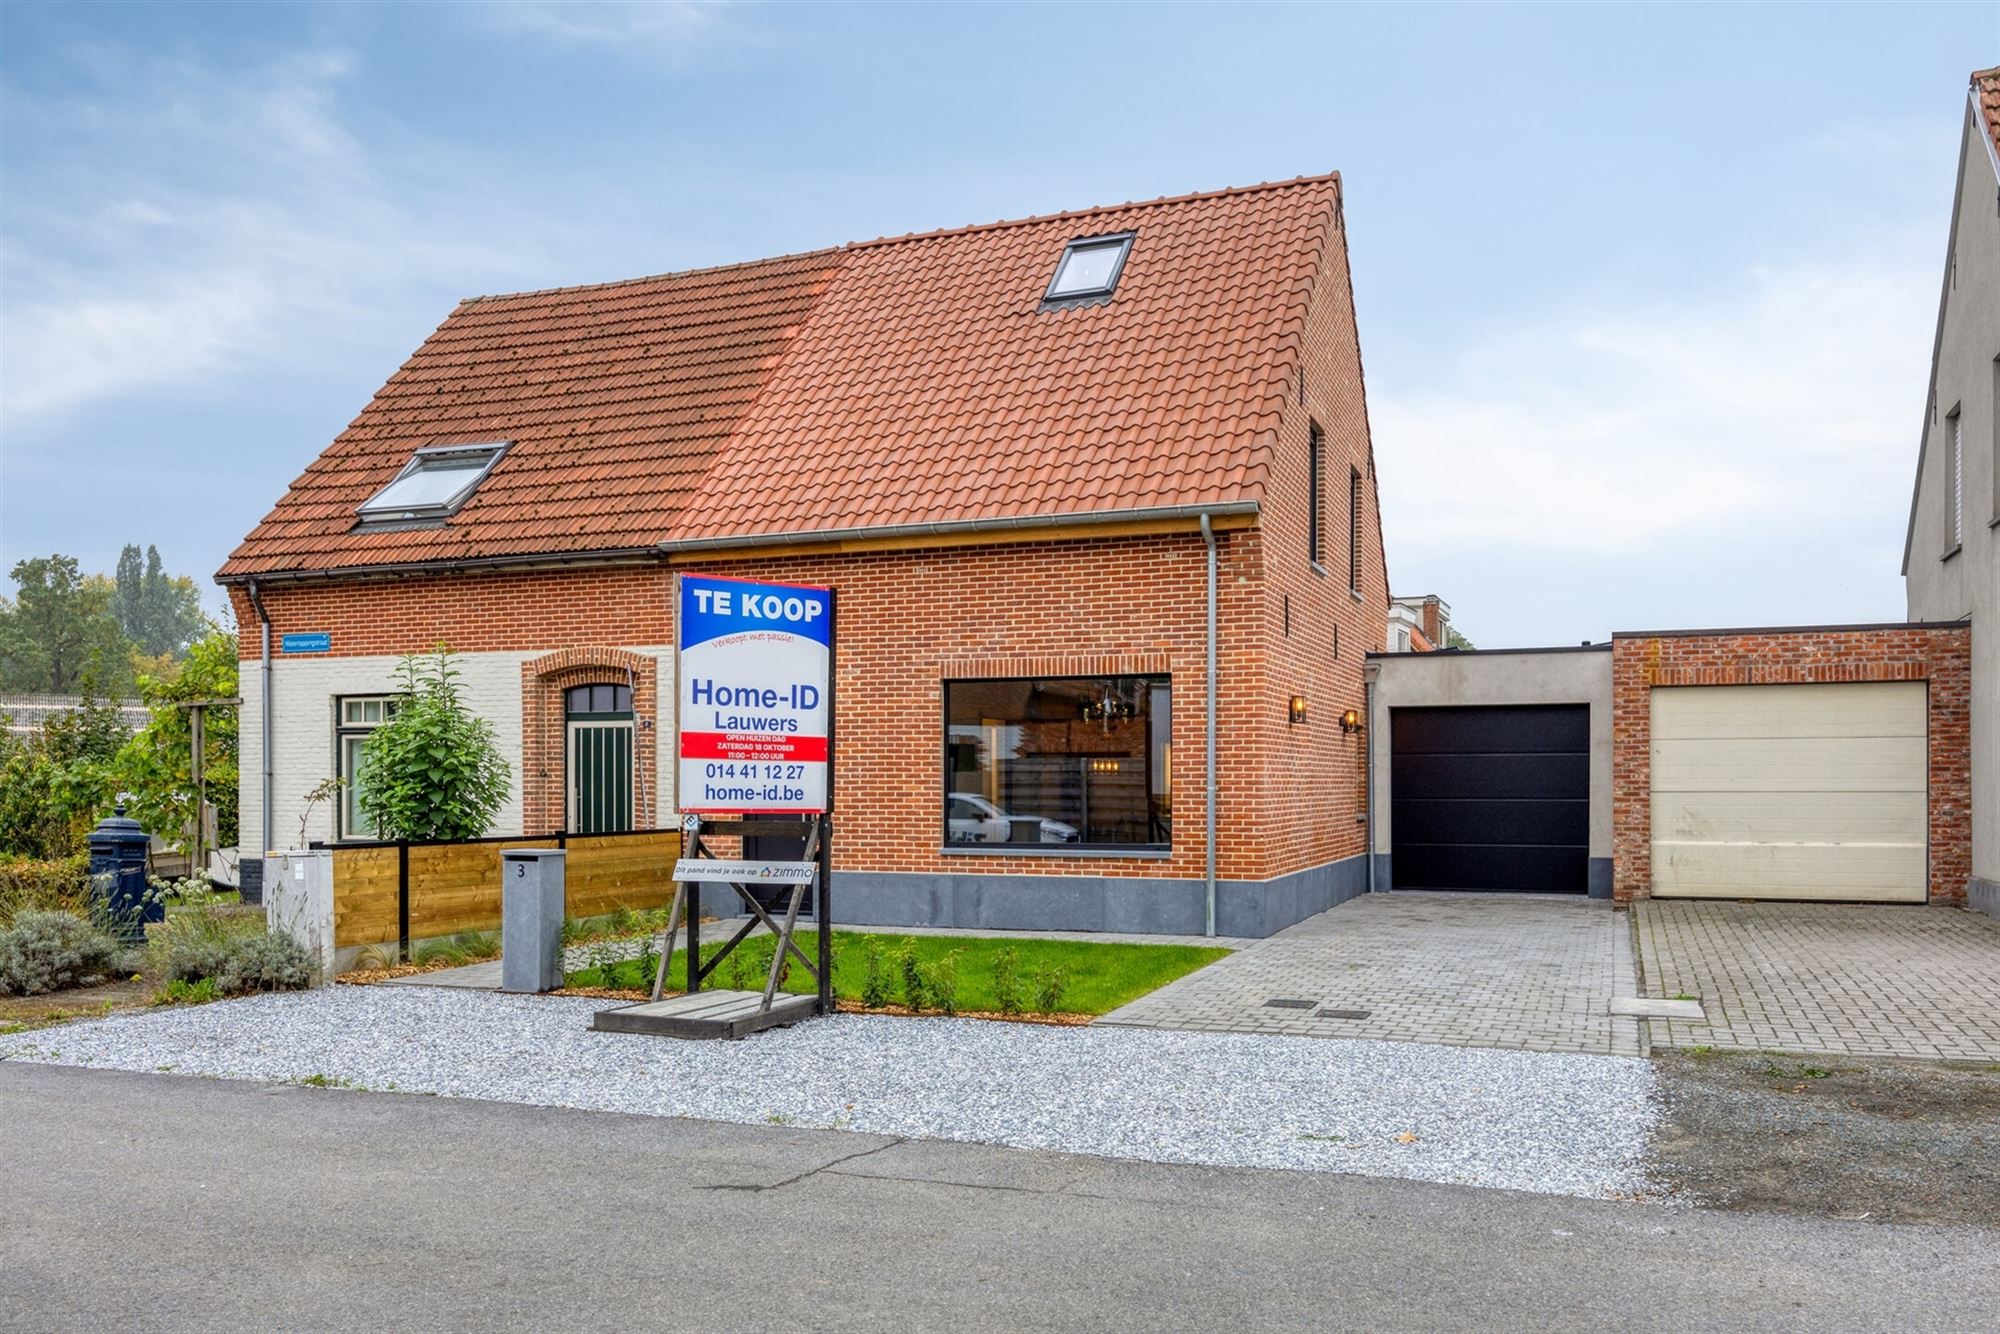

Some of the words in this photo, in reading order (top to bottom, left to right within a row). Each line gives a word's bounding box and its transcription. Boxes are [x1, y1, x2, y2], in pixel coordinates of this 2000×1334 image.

[693, 589, 732, 615] TE
[741, 593, 823, 622] KOOP
[749, 633, 766, 641] met
[692, 678, 820, 711] Home-ID
[715, 711, 798, 732] Lauwers
[726, 734, 745, 742] OPEN
[772, 735, 787, 743] DAG
[717, 742, 753, 750] ZATERDAG
[755, 743, 762, 751] 18
[763, 743, 795, 752] OKTOBER
[728, 751, 745, 759] 11:00
[771, 752, 784, 760] UUR
[706, 763, 735, 778] 014
[740, 764, 757, 779] 41
[764, 765, 782, 779] 12
[786, 765, 805, 779] 27
[705, 784, 804, 800] home-id.be
[517, 863, 525, 878] 3
[687, 867, 705, 875] pand
[722, 868, 730, 876] je
[772, 868, 813, 878] zimmo
